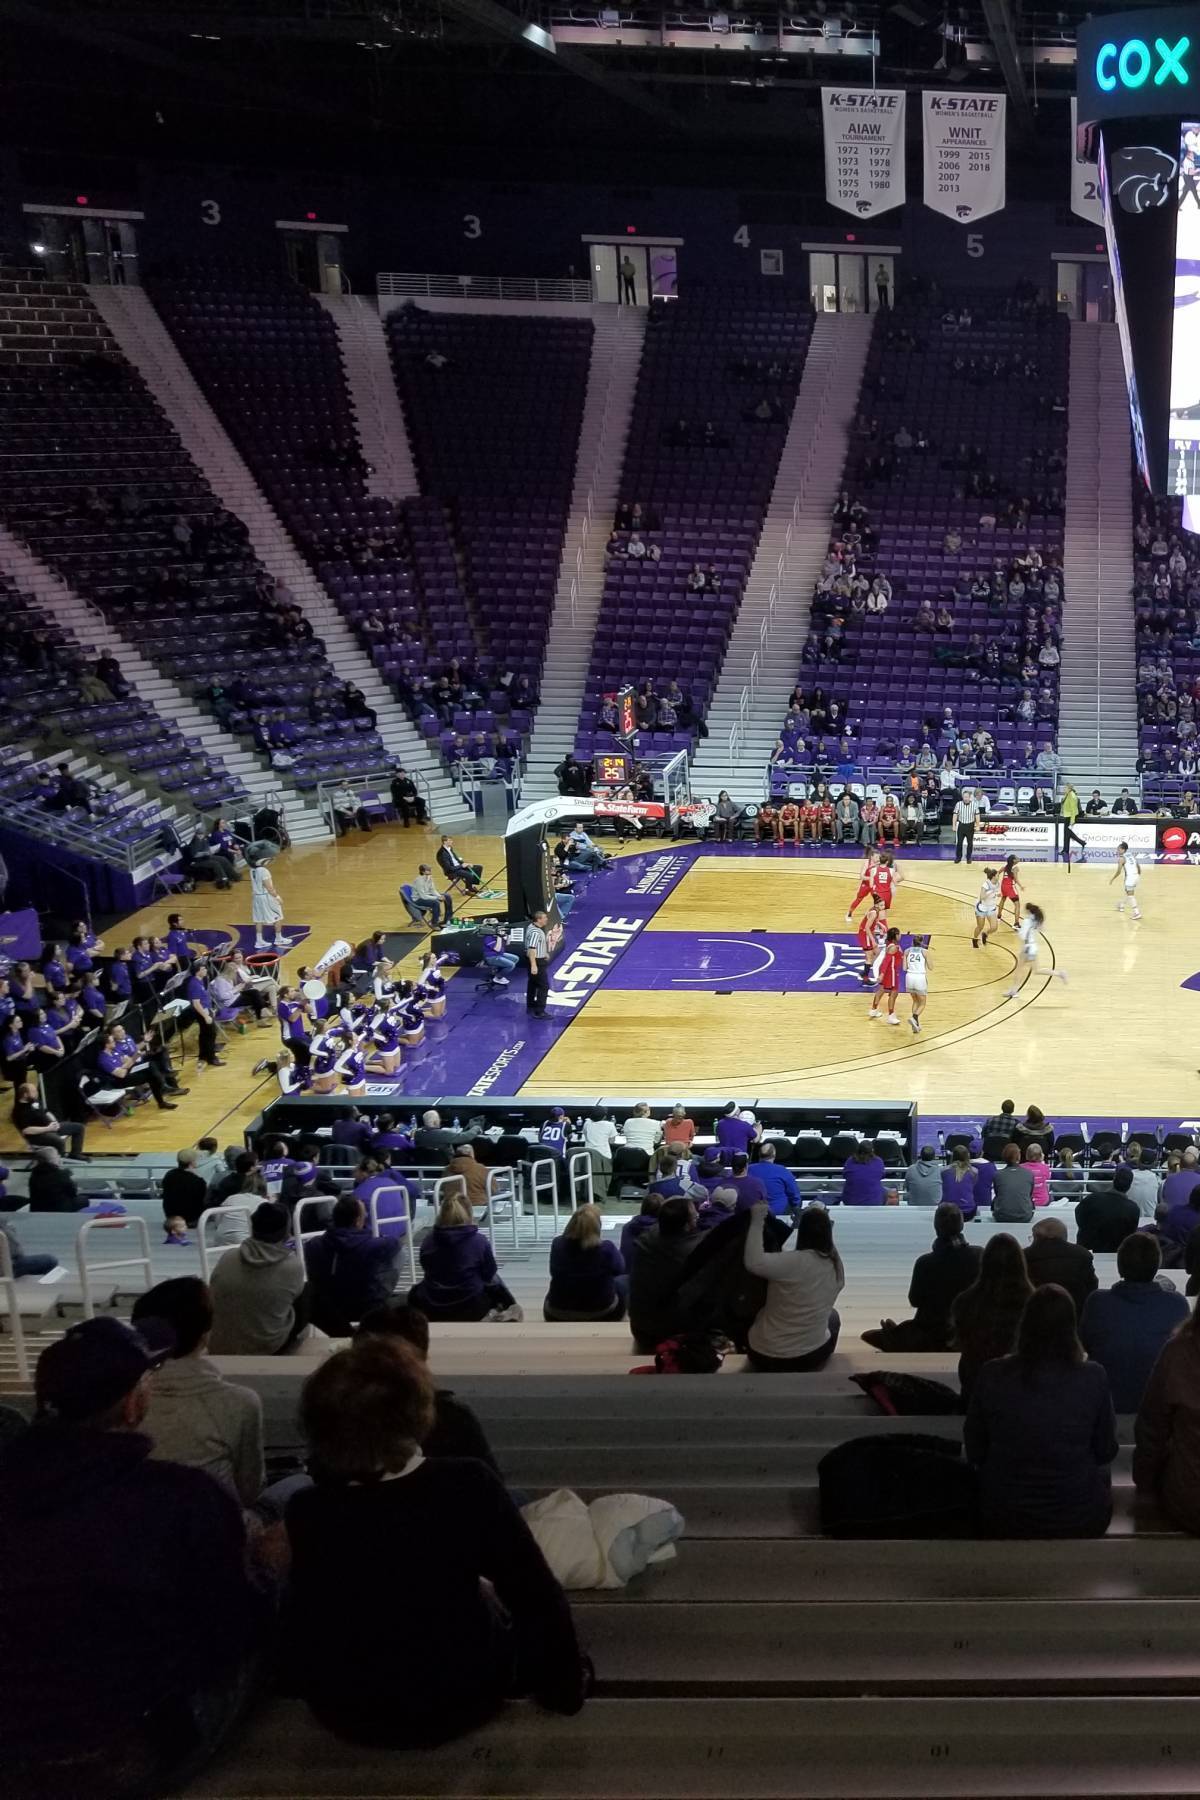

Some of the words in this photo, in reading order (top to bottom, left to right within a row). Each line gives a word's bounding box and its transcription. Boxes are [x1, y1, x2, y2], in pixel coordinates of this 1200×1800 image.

[1096, 37, 1190, 91] COX
[829, 93, 899, 108] K-STATE
[930, 97, 998, 112] K-STATE
[860, 107, 893, 115] BASKETBALL
[848, 123, 881, 134] AIAW
[949, 127, 981, 139] WNIT
[838, 146, 859, 154] 1972
[869, 148, 890, 156] 1977
[968, 152, 990, 160] 2015
[838, 157, 859, 165] 1973
[869, 159, 890, 167] 1978
[938, 162, 960, 170] 2006
[968, 163, 990, 171] 2018
[838, 168, 859, 176] 1974
[869, 170, 890, 178] 1979
[938, 173, 960, 181] 2007
[838, 179, 859, 187] 1975
[869, 181, 890, 189] 1980
[938, 184, 960, 192] 2013
[838, 190, 859, 198] 1976
[201, 200, 221, 225] 3
[463, 215, 482, 239] 3
[733, 225, 750, 248] 4
[966, 234, 984, 258] 5
[1081, 834, 1126, 842] SMOOTHIE
[1128, 834, 1150, 843] KING
[546, 916, 644, 1008] K-STATE
[910, 953, 921, 963] 24
[543, 1126, 560, 1141] 20
